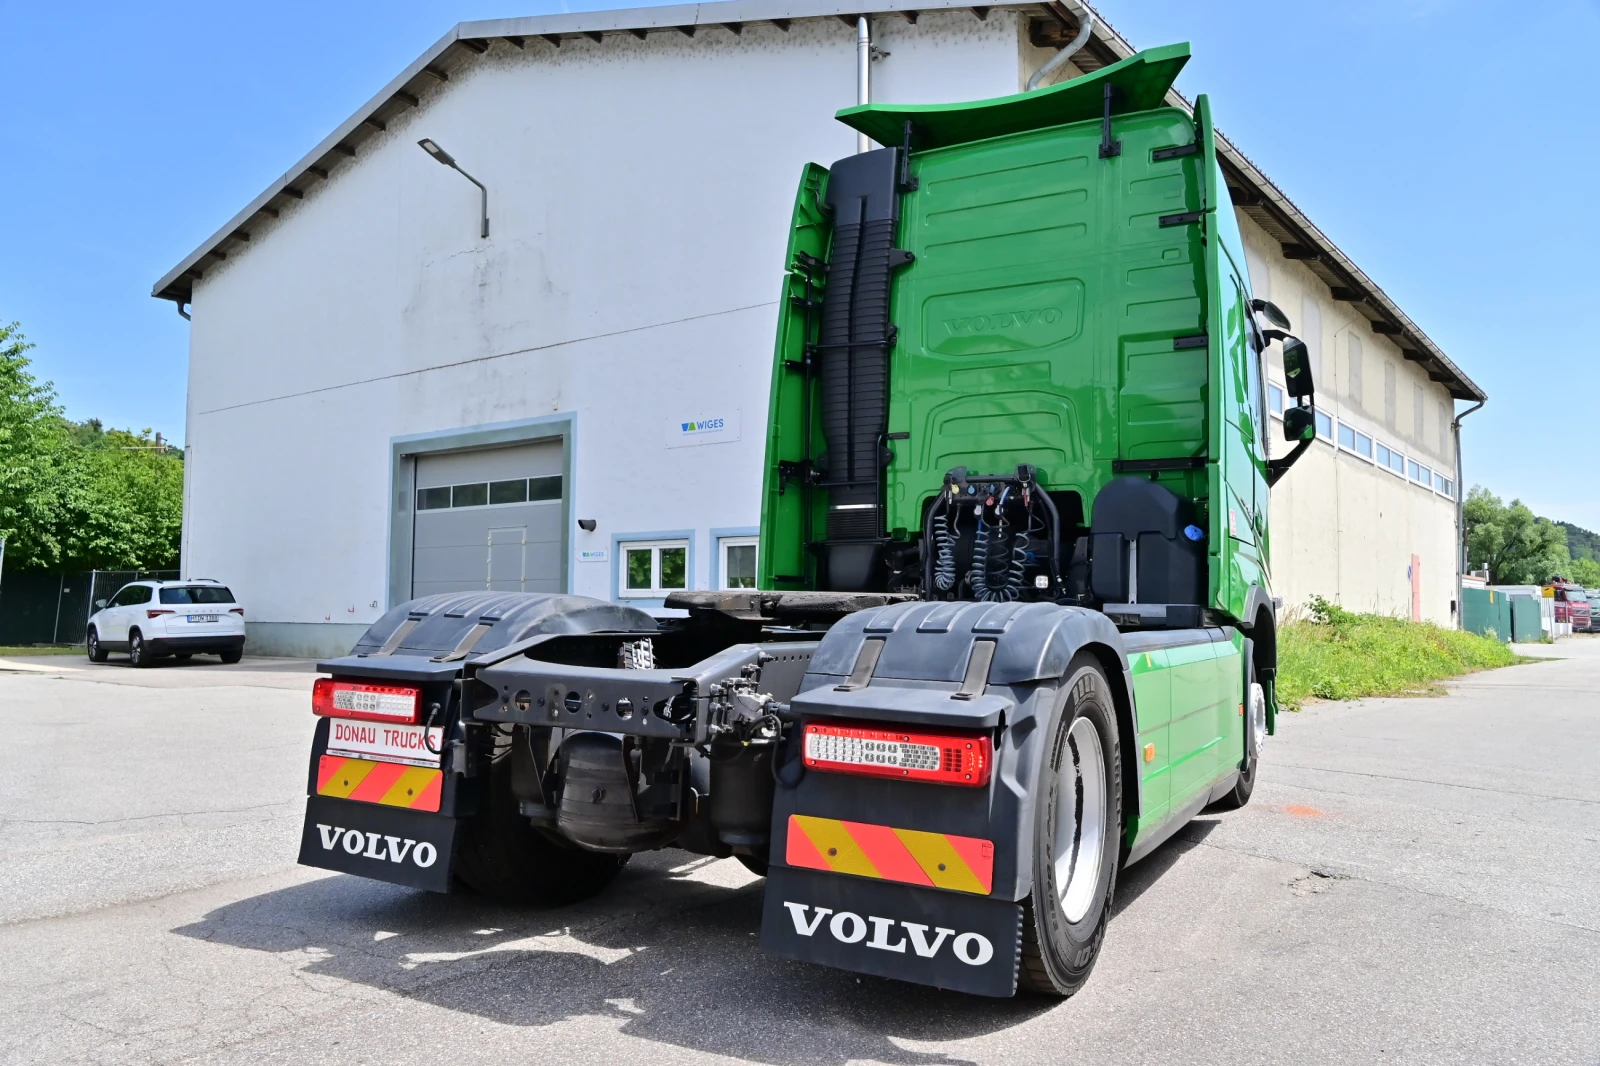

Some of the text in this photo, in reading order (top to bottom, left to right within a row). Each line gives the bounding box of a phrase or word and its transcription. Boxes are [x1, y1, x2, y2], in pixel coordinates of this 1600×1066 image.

[942, 307, 1063, 335] VOLVO
[696, 418, 724, 430] WIGES
[335, 723, 436, 751] DONAU TRUCKS
[316, 823, 438, 868] VOLVO
[783, 901, 994, 966] VOLVO
